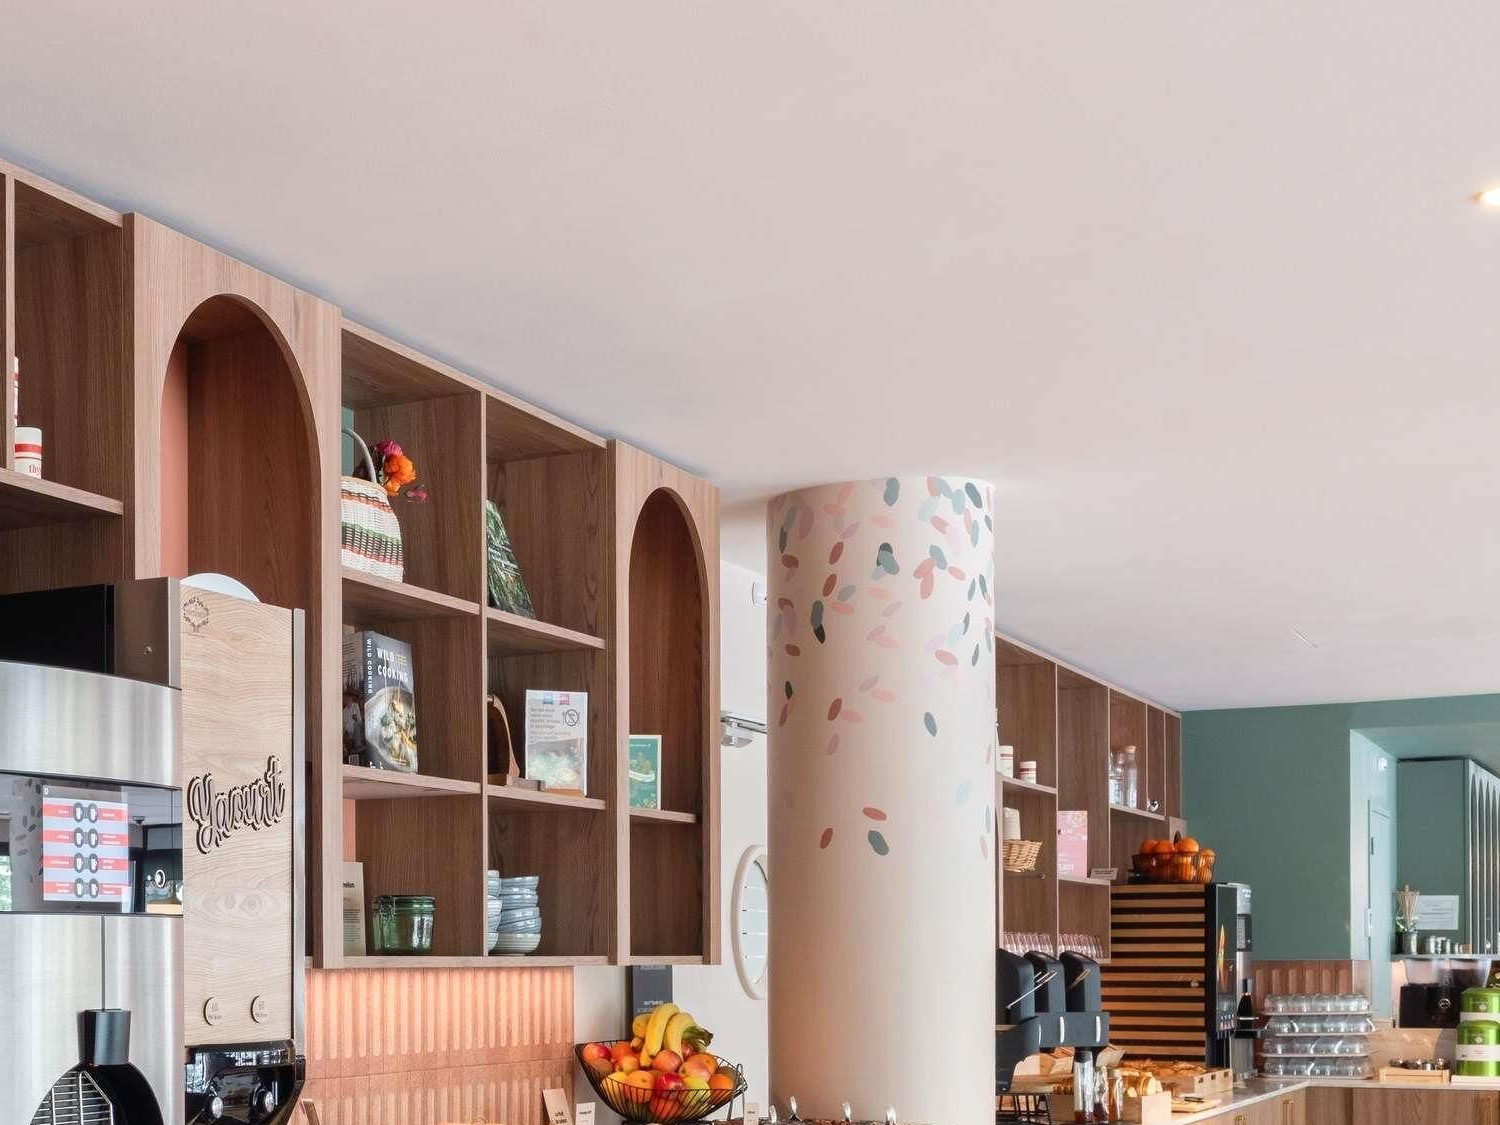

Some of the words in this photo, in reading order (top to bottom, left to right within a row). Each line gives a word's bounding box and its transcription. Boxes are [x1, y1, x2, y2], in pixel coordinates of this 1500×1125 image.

[376, 647, 395, 663] WILD
[377, 664, 409, 682] COOKING
[187, 755, 285, 854] Yaourt
